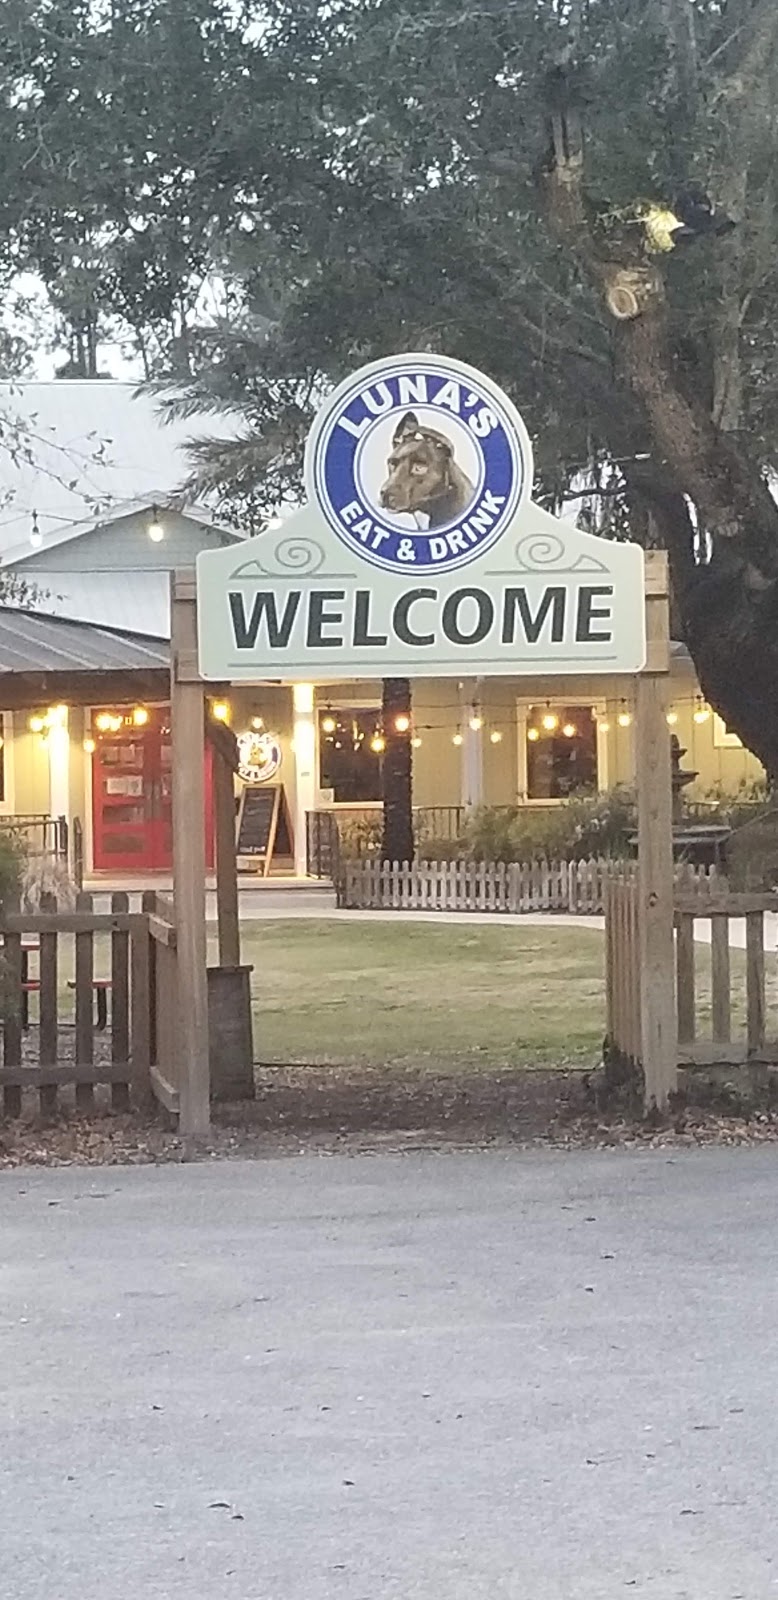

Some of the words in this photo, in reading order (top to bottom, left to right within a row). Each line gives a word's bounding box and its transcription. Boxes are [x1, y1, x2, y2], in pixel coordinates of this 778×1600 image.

[338, 375, 498, 438] LUNA'S
[339, 501, 391, 549] EAT
[397, 539, 416, 561] &
[430, 491, 506, 560] DRINK
[228, 586, 613, 649] WELCOME
